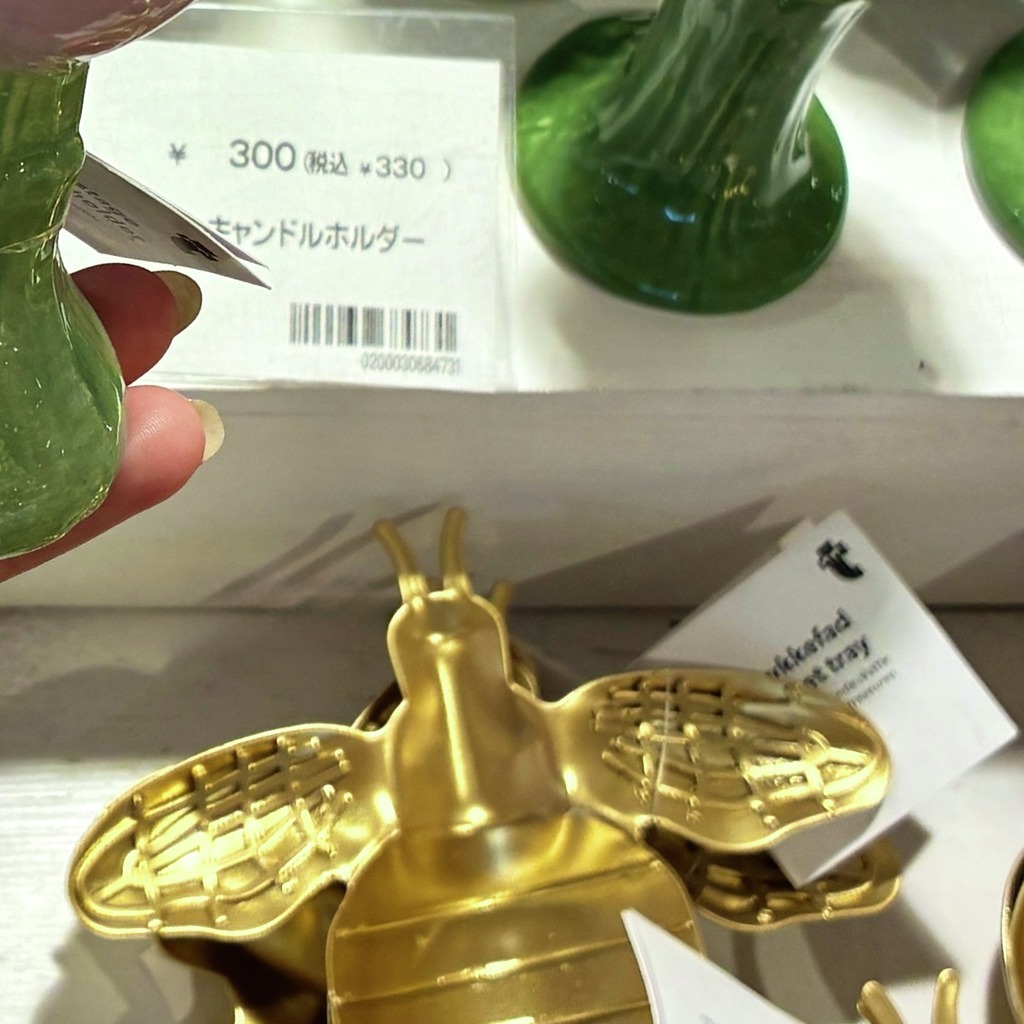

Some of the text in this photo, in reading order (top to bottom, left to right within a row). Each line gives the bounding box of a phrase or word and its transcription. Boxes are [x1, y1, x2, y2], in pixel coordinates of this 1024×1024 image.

[229, 139, 297, 172] 300
[208, 216, 426, 254] キャンドルホルダー
[825, 633, 873, 674] tray
